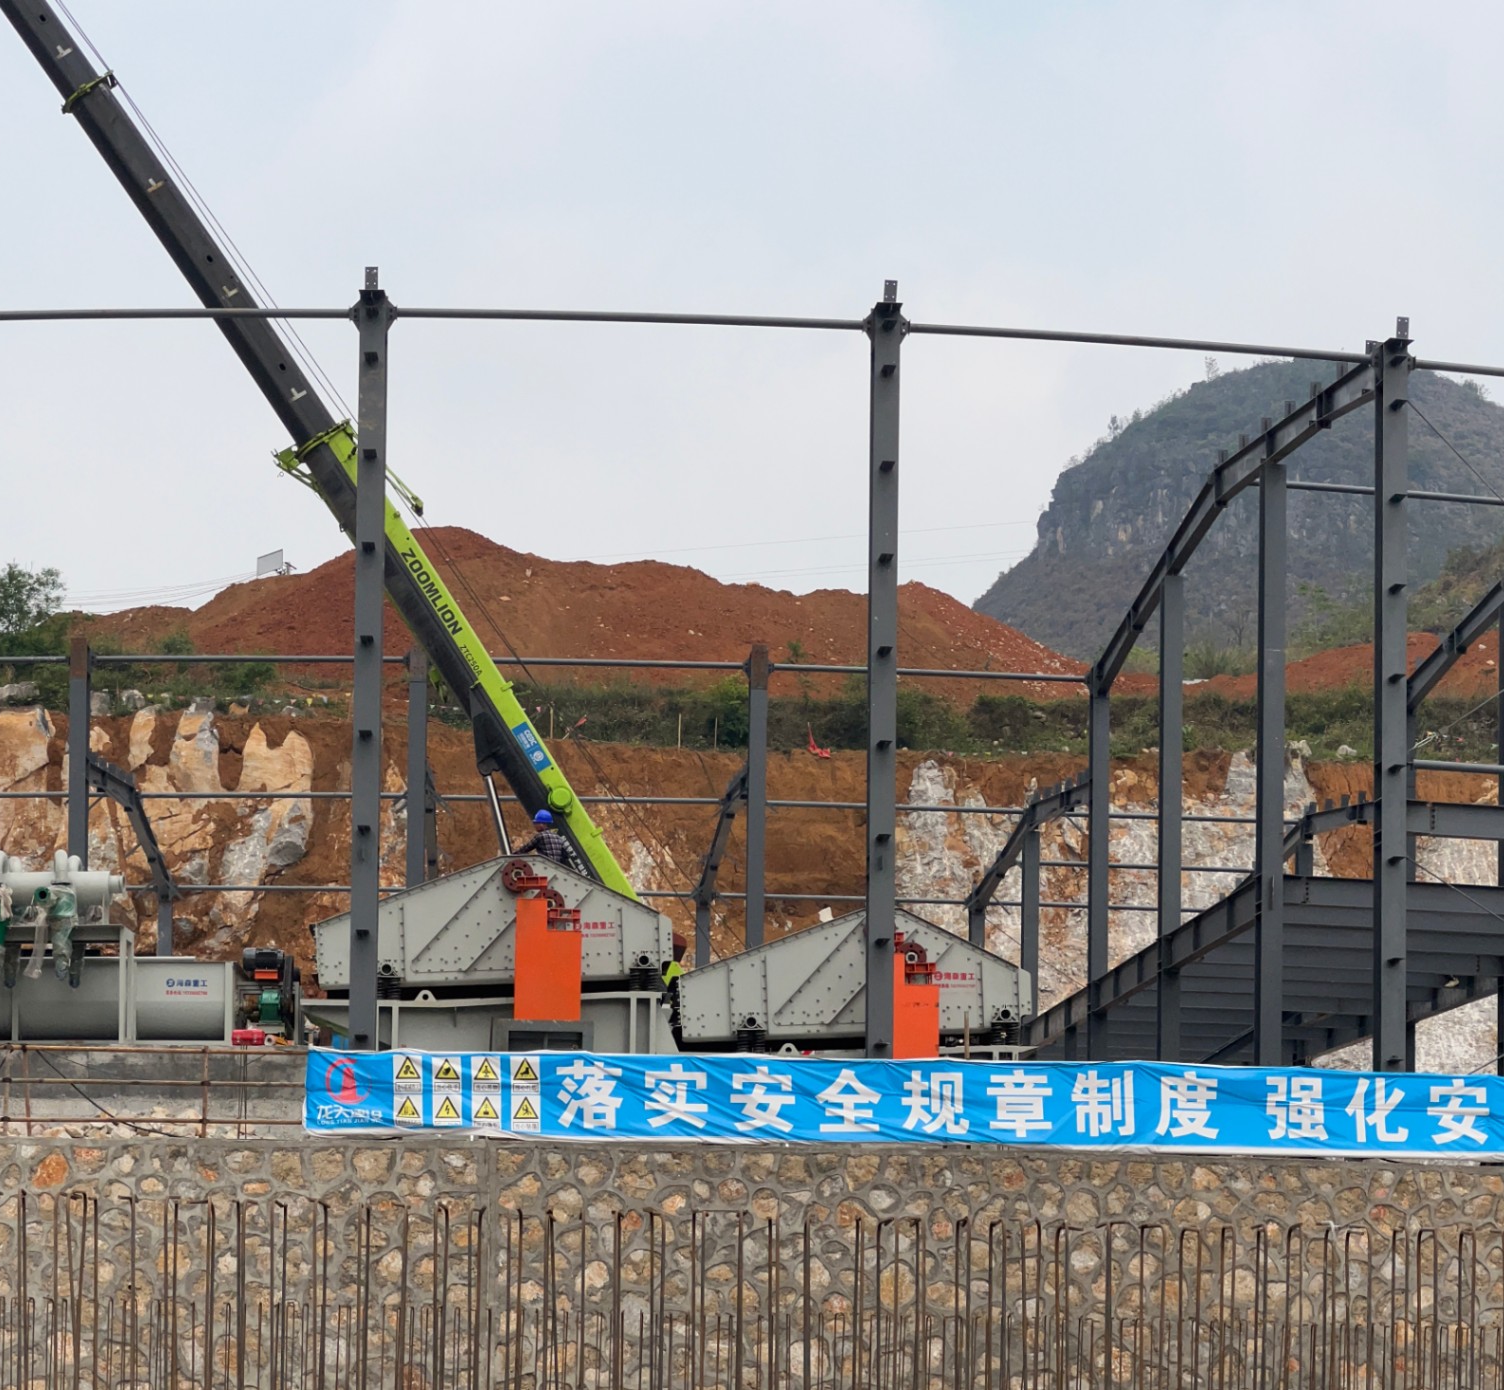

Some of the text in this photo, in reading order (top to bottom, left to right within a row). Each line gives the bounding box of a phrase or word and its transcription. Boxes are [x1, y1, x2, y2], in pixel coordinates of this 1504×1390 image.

[401, 547, 463, 636] ZOOMLION
[556, 1059, 1218, 1140] 落实安全规章制度
